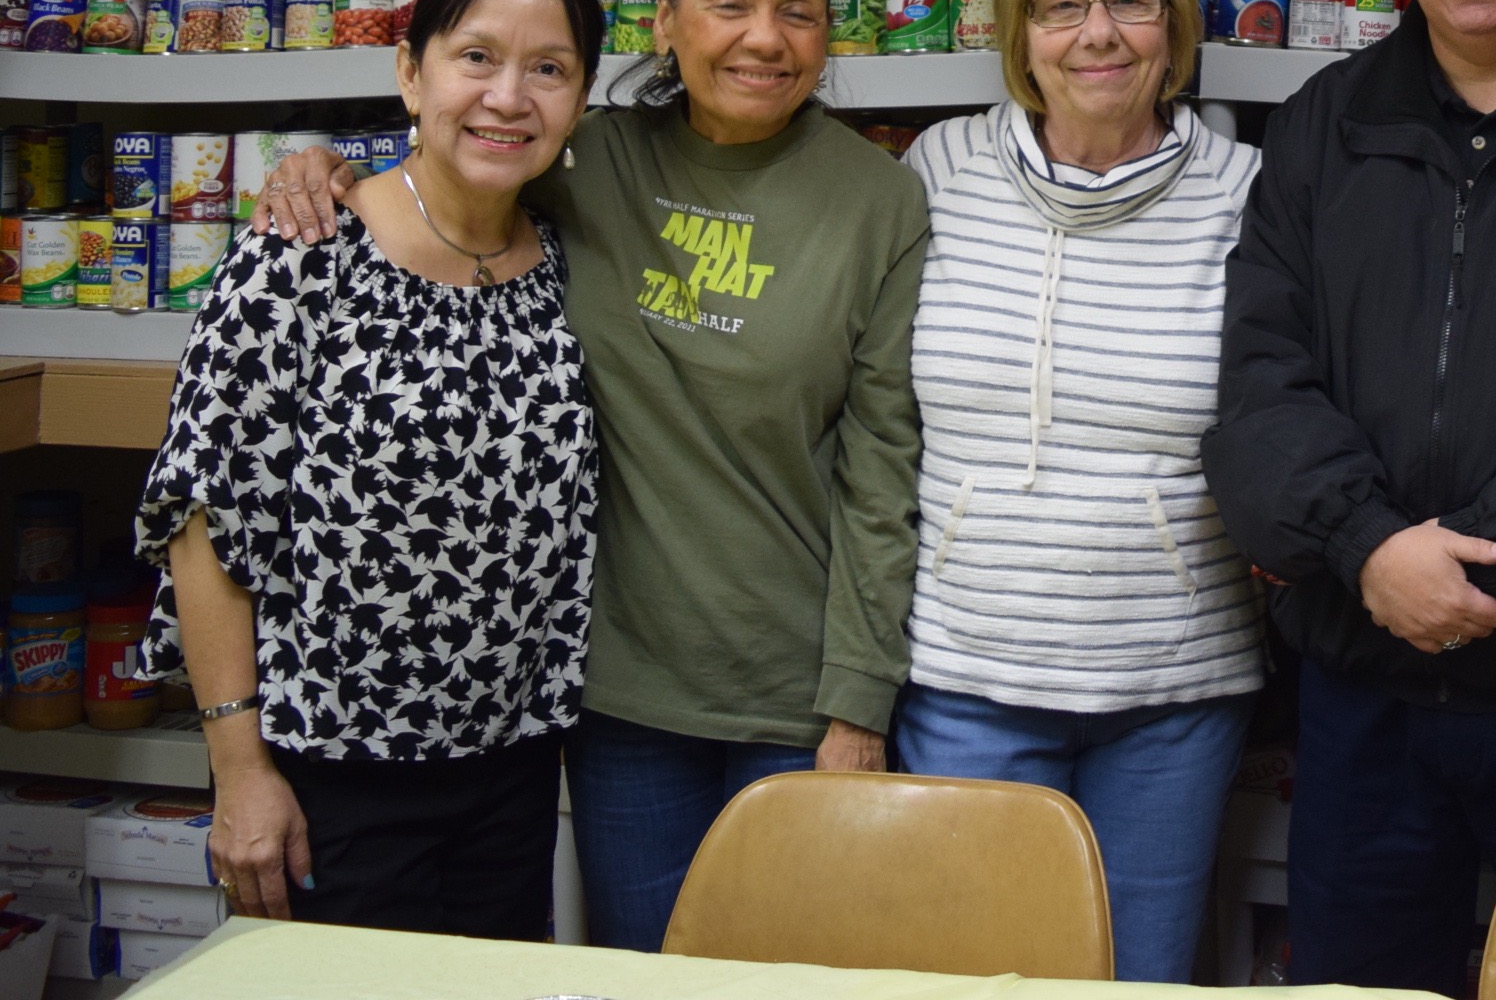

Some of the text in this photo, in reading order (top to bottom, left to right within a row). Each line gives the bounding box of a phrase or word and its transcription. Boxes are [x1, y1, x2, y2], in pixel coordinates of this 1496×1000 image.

[33, 3, 74, 14] Black Beans
[1359, 21, 1391, 31] Chicken
[673, 202, 755, 222] HALF MARATHON SERIES
[39, 241, 65, 249] Golden
[660, 212, 753, 262] MAN
[688, 255, 775, 299] HAT
[677, 321, 696, 333] 2011
[697, 310, 744, 333] HALF
[14, 643, 66, 671] SKIPPY
